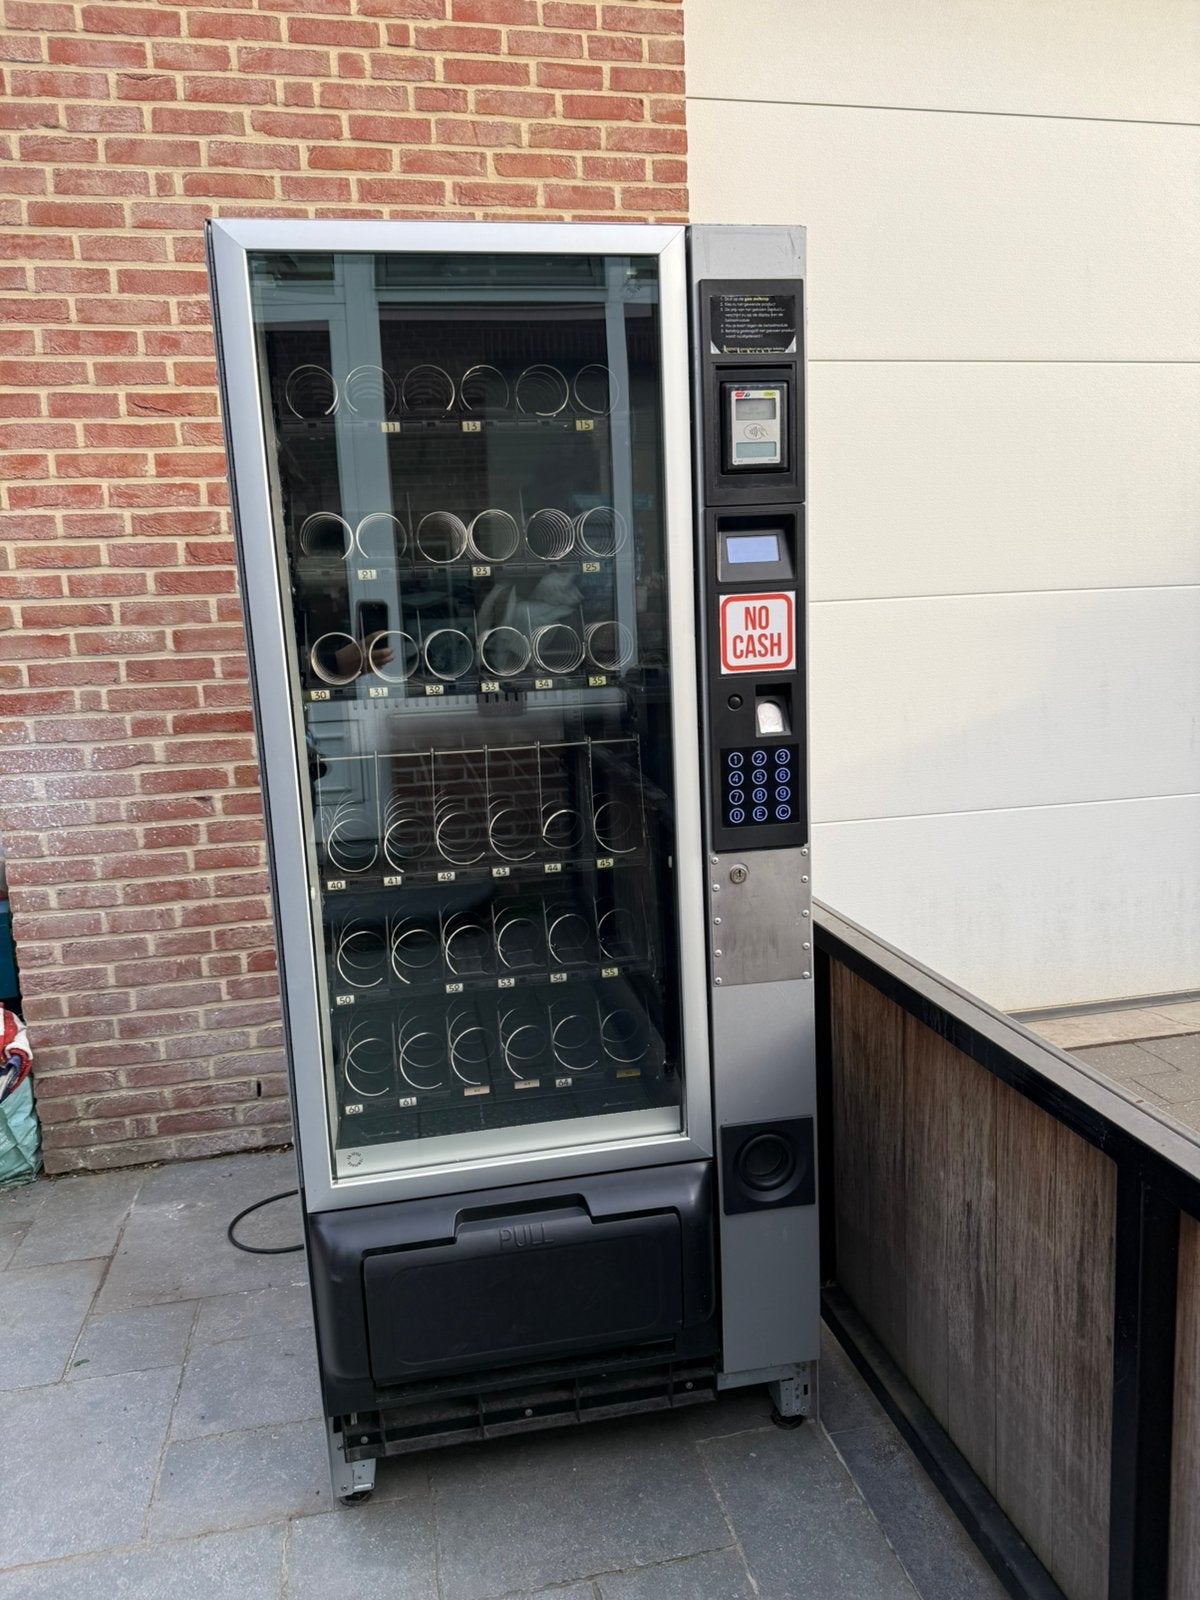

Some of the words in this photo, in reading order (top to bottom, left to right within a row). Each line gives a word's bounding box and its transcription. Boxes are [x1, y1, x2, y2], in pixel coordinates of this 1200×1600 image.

[744, 605, 770, 631] NO
[732, 633, 782, 659] CASH
[499, 1222, 555, 1250] PULL
